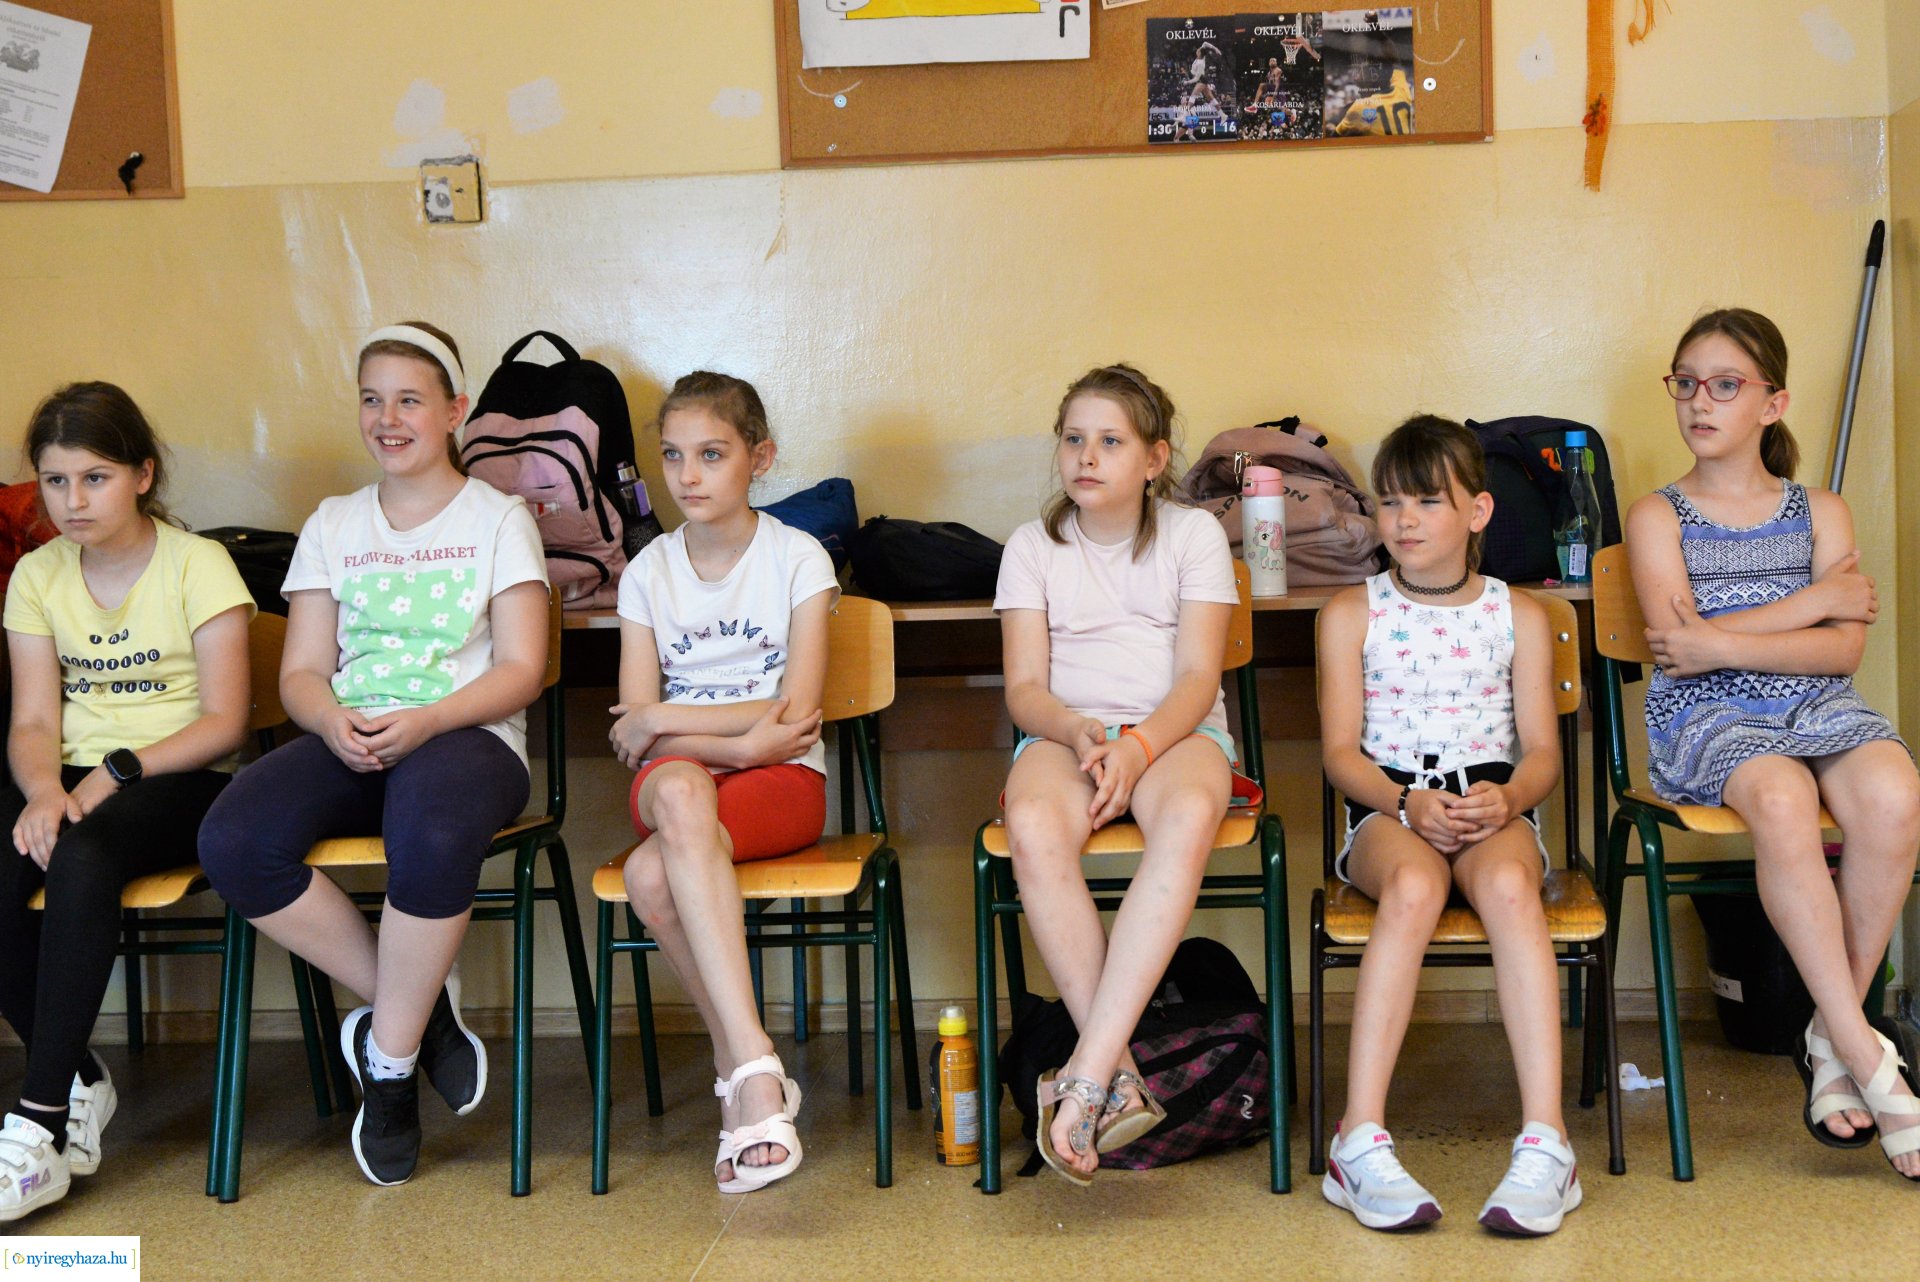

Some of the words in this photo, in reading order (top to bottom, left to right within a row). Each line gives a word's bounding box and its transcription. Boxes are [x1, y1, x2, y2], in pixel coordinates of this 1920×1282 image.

[1165, 27, 1216, 40] OKLEVÉL
[344, 551, 404, 568] FLOWER
[1373, 1132, 1389, 1144] NIKE
[1522, 1135, 1542, 1145] NIKE
[19, 1167, 51, 1196] FILA
